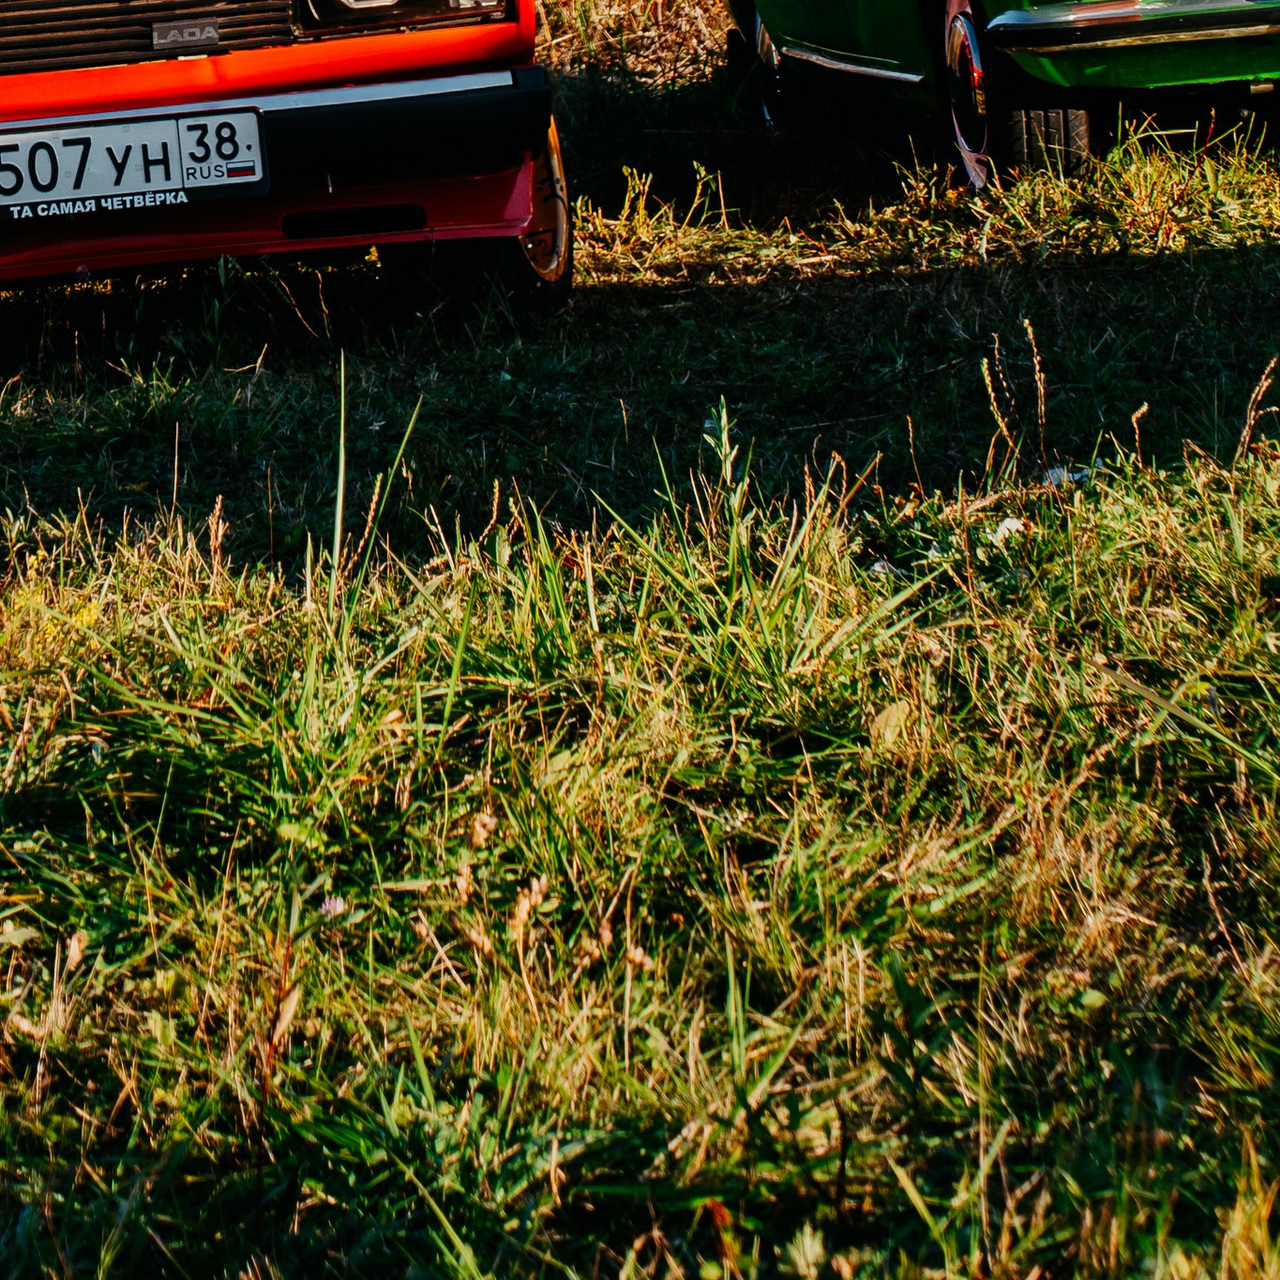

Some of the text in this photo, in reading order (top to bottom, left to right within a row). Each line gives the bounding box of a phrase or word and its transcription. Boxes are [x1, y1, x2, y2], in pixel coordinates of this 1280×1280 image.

[153, 26, 219, 45] LADA
[186, 121, 240, 164] 38
[186, 164, 226, 181] RUS
[10, 191, 189, 220] ТА САМАЯ ЧЕТВЁРКА
